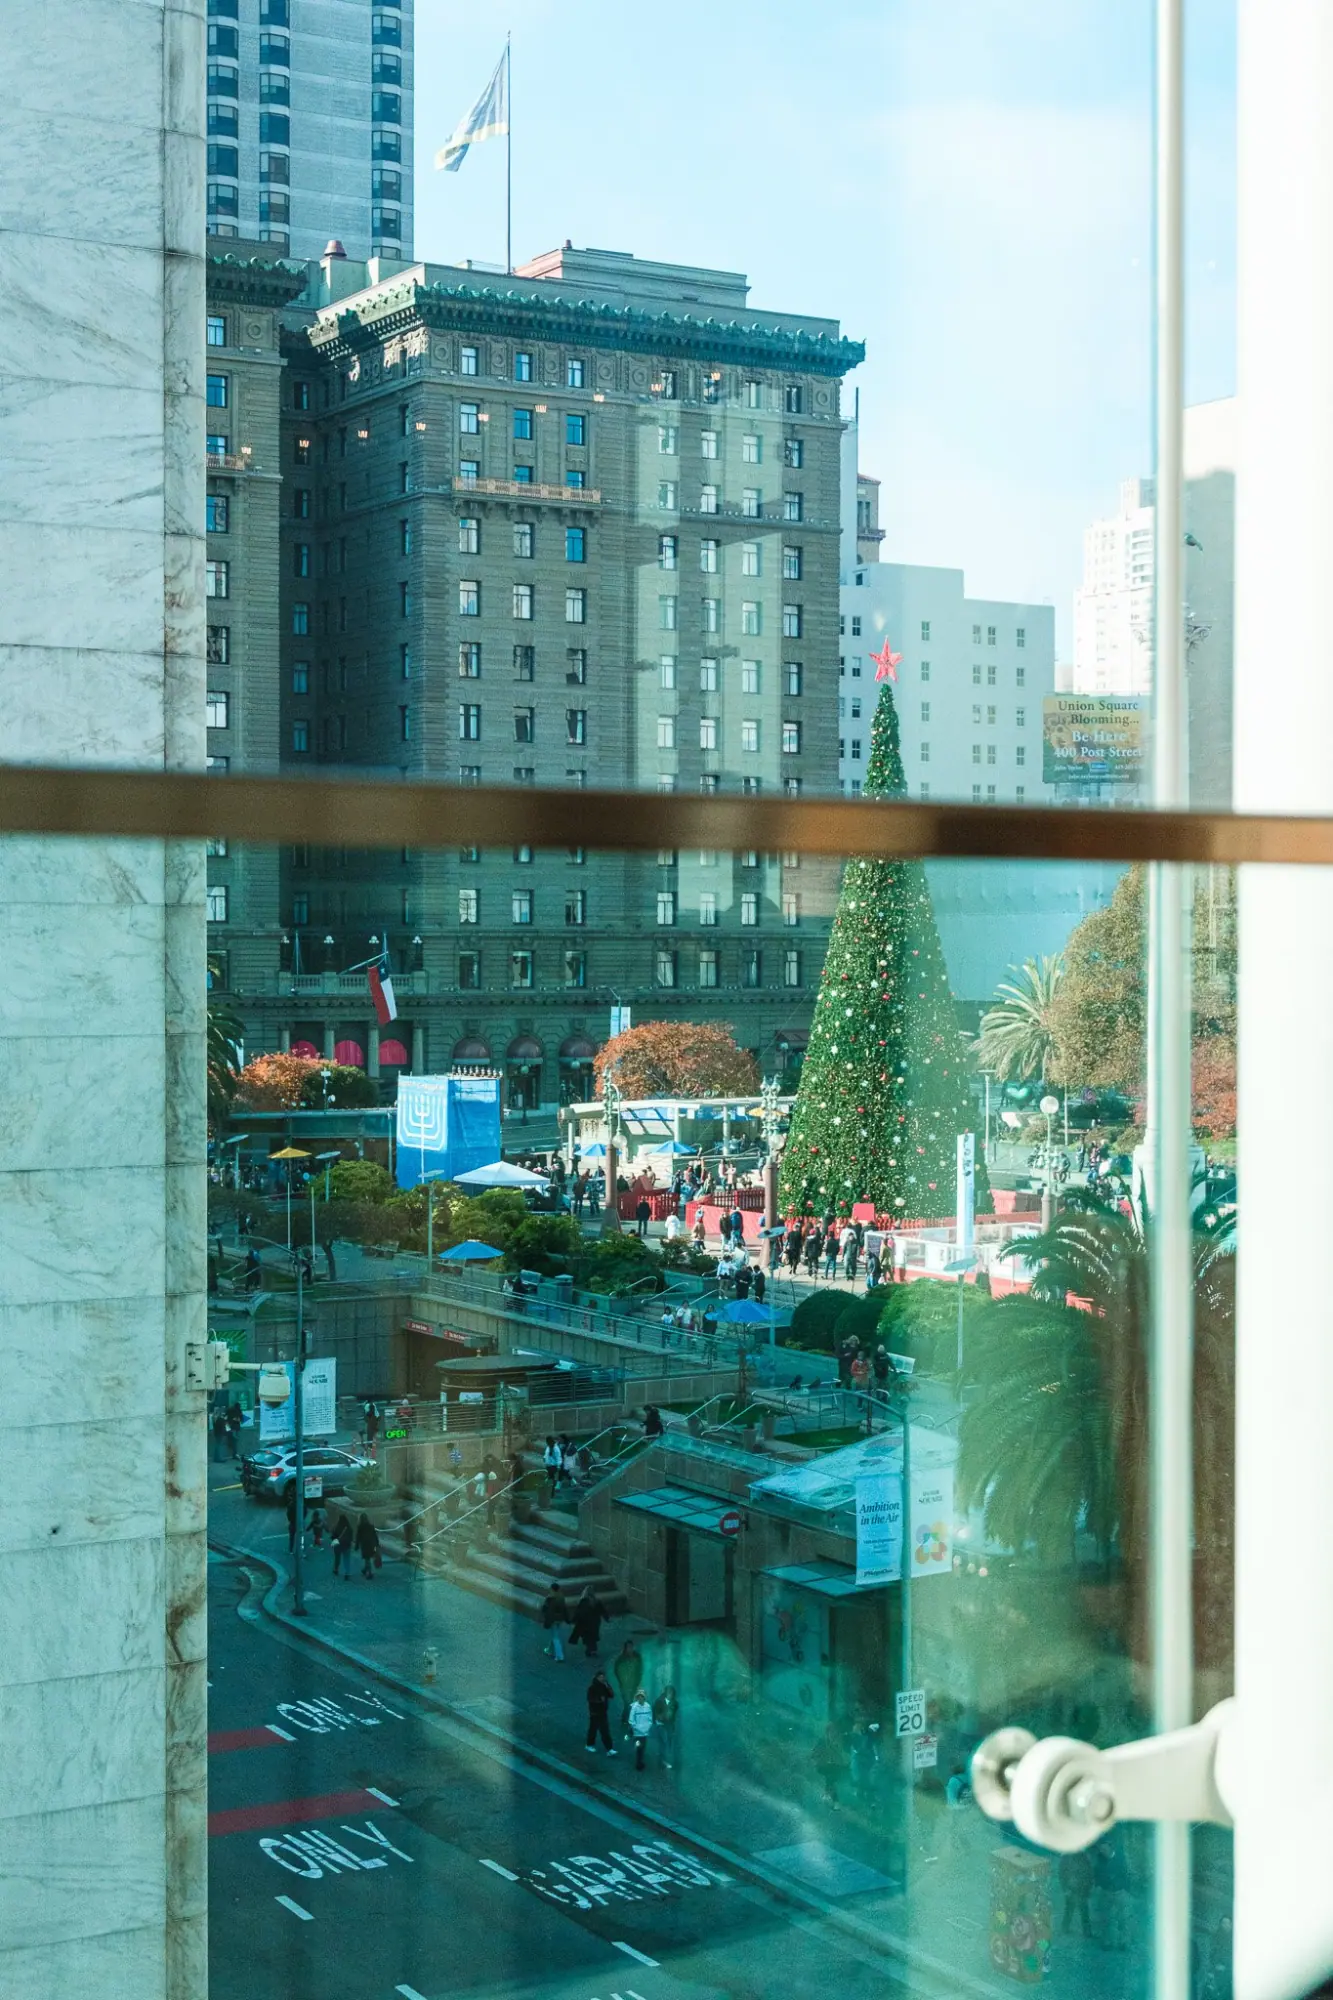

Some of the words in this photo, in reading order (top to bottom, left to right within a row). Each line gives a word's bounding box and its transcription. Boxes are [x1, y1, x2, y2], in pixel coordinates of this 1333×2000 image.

[1058, 700, 1095, 711] Union
[1099, 700, 1139, 712] Square
[1072, 730, 1089, 742] Be
[1054, 747, 1077, 758] 400
[1081, 747, 1107, 758] Post
[1109, 747, 1143, 758] Street
[385, 1429, 407, 1439] OPEN
[859, 1501, 900, 1514] Ambition
[860, 1515, 870, 1526] in
[871, 1513, 885, 1525] the
[885, 1513, 900, 1523] Air
[898, 1693, 924, 1704] SPEED
[276, 1690, 406, 1734] ONLY
[900, 1703, 921, 1713] LIMIT
[899, 1713, 923, 1733] 20
[259, 1820, 415, 1879] ONLY
[521, 1841, 736, 1911] GARAGE
